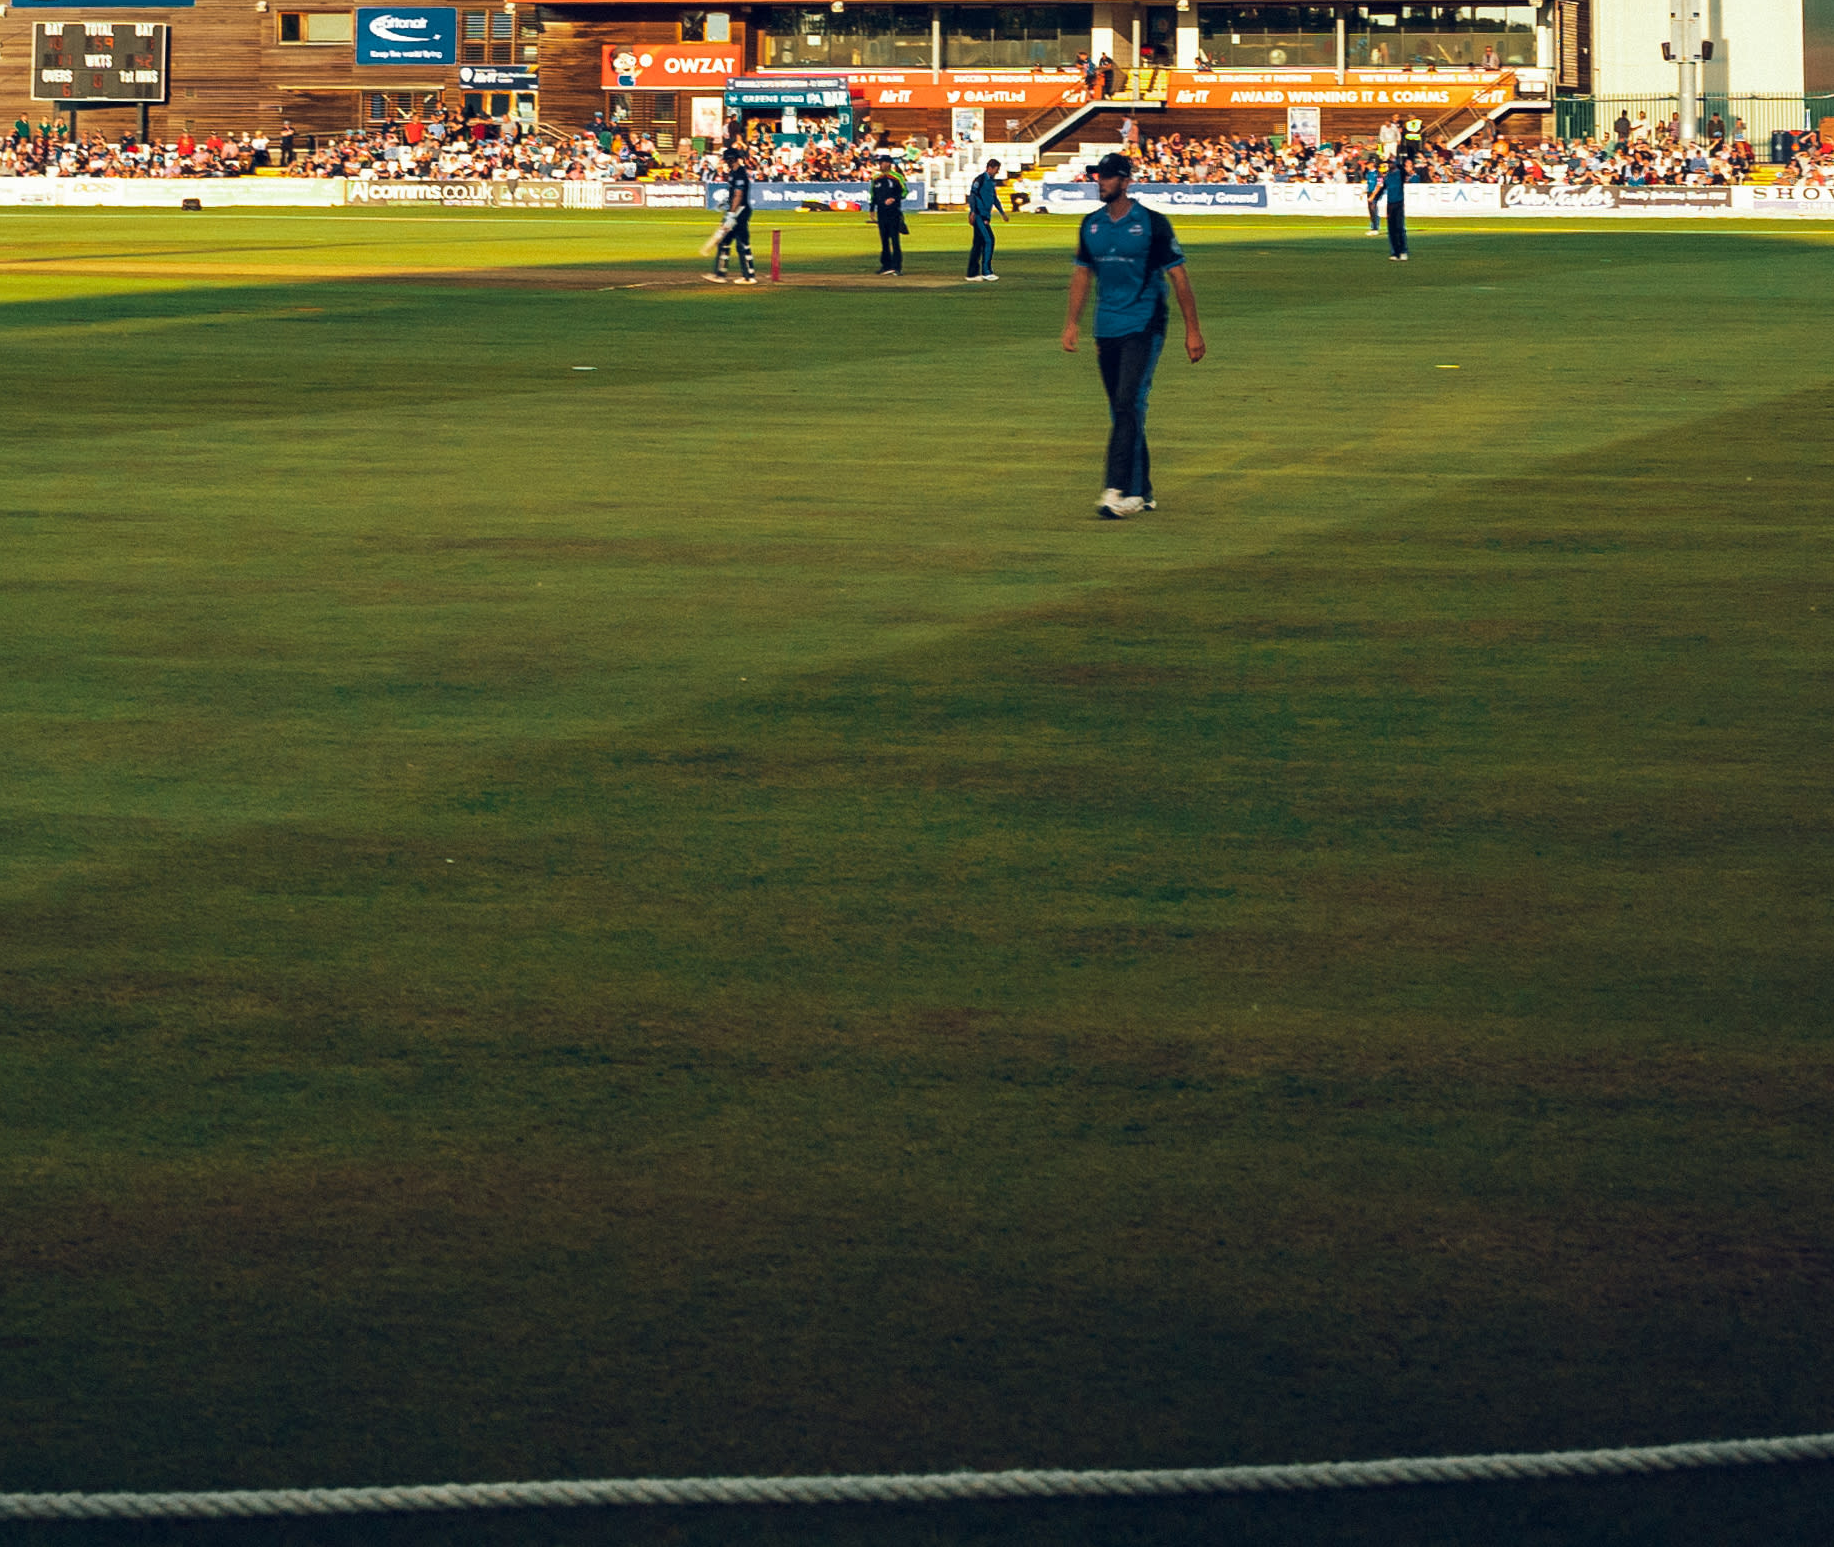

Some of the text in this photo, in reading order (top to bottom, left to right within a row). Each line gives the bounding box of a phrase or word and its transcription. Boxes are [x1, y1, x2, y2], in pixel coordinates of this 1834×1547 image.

[84, 23, 114, 36] TOTAL
[84, 54, 113, 68] WKTS
[664, 57, 735, 73] OWZAT
[41, 69, 74, 83] OVERS
[1231, 91, 1449, 103] AWARD WINNING IT & COMMS
[1172, 191, 1213, 205] County
[1216, 192, 1259, 203] Ground
